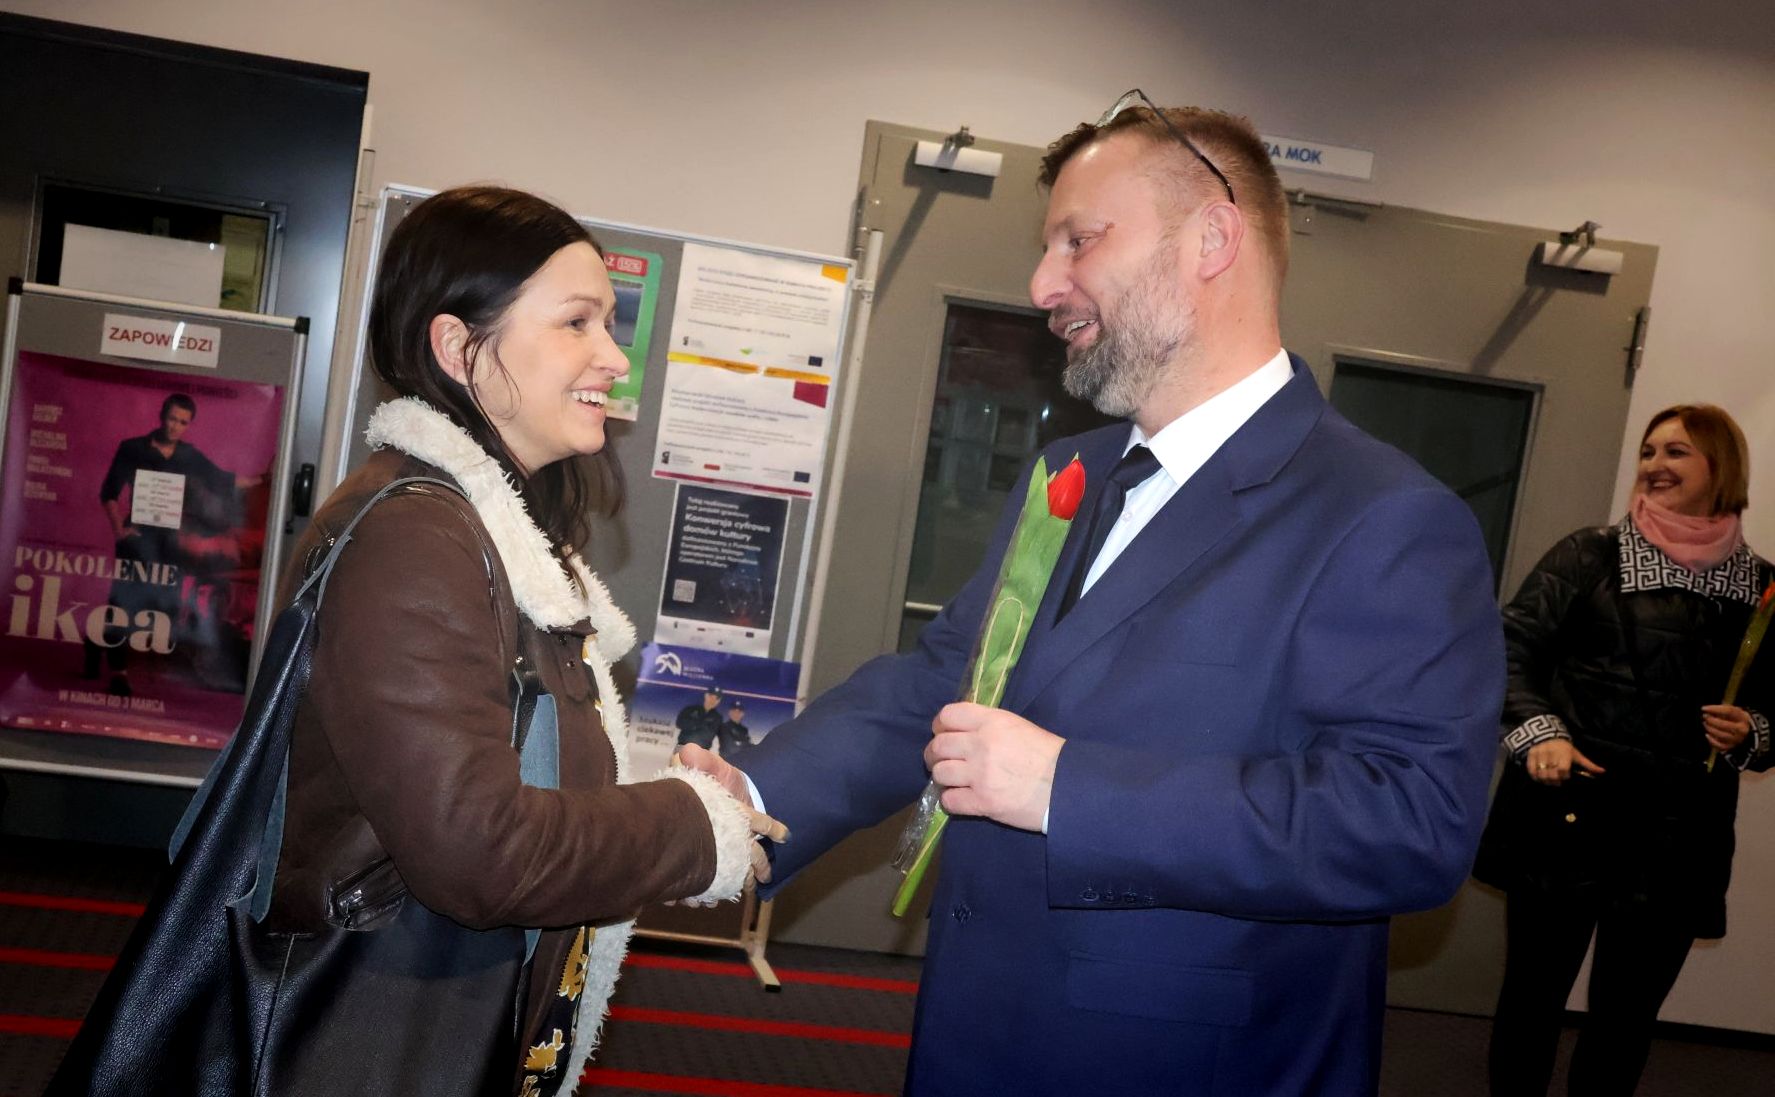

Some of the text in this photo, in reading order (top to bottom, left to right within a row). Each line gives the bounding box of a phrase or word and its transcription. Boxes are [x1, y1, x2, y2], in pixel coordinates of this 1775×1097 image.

[1285, 146, 1322, 165] MOK
[109, 327, 213, 352] ZAPOWEDZI
[683, 524, 752, 542] domów kultury
[685, 513, 771, 533] Konwersja cyfrowa
[14, 546, 179, 587] POKOLENIE
[5, 573, 177, 655] ikea
[70, 690, 106, 707] KINACH
[130, 697, 165, 713] MARCA
[637, 725, 674, 738] ciekawej
